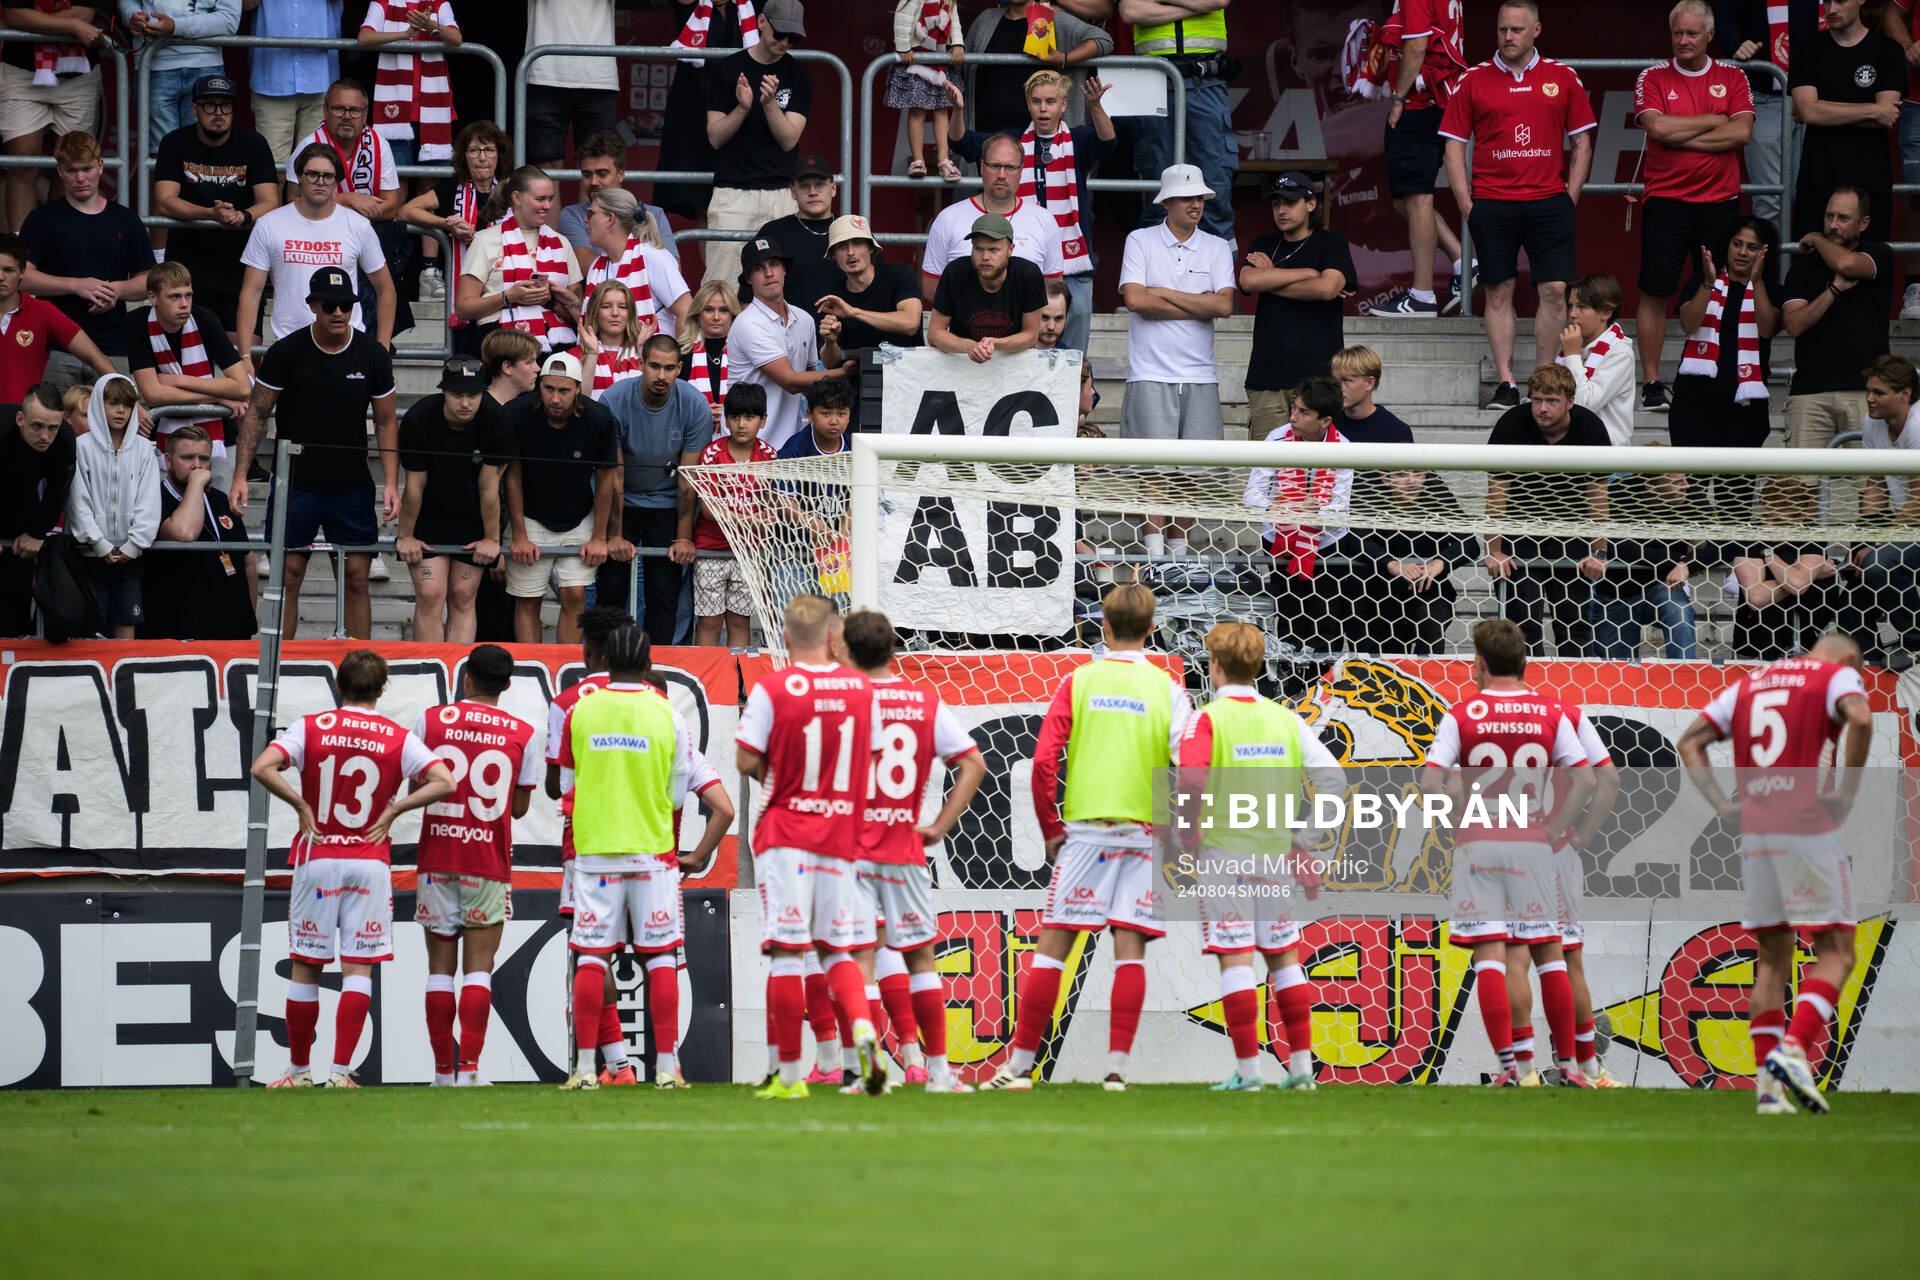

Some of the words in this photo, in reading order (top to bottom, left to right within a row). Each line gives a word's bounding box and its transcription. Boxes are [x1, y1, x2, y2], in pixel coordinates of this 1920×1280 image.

[1492, 147, 1552, 161] Hjältevadshus
[284, 239, 342, 252] SYDOST
[284, 251, 342, 265] KURVAN
[893, 496, 1063, 588] AB
[813, 677, 864, 691] REDEYE
[814, 699, 847, 713] RING
[1091, 697, 1146, 713] YASKAWA
[1494, 702, 1548, 716] REDEYE
[342, 718, 395, 737] REDEYE
[465, 711, 518, 731] REDEYE
[1476, 721, 1542, 736] SVENSSON
[444, 728, 506, 746] ROMARIO
[1750, 690, 1790, 769] 5
[321, 735, 385, 754] KARLSSON
[592, 737, 647, 750] YASKAWA
[1234, 745, 1286, 757] YASKAWA
[802, 715, 855, 792] 11
[427, 744, 513, 823] 29
[1468, 741, 1549, 815] 28
[317, 754, 380, 829] 13
[863, 808, 915, 826] earyou
[430, 822, 494, 844] nearyou
[1073, 886, 1095, 899] ICA
[467, 907, 488, 922] ICA
[651, 910, 670, 922] ICA
[302, 919, 318, 933] ICA
[365, 920, 382, 933] ICA
